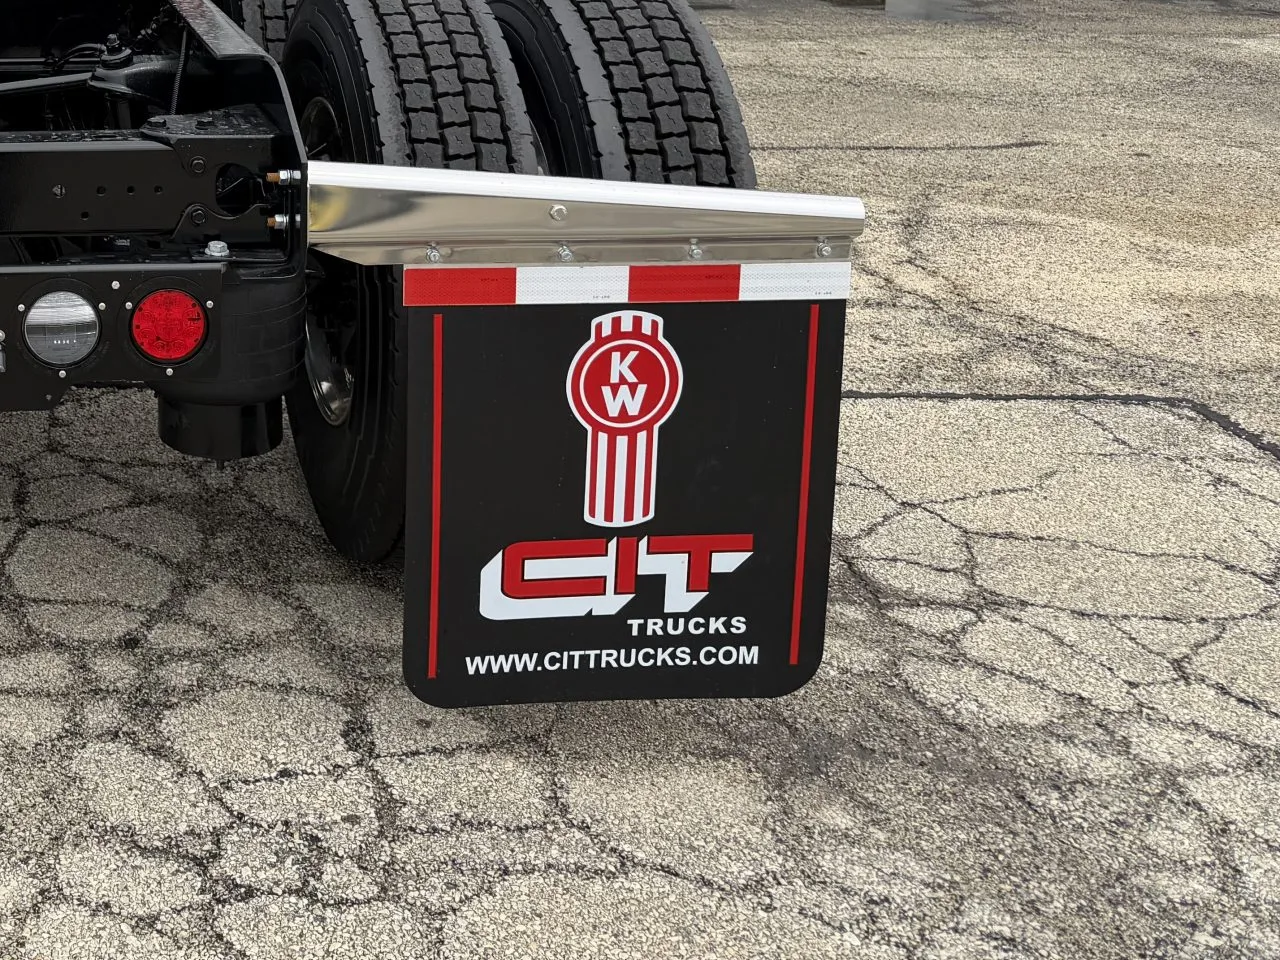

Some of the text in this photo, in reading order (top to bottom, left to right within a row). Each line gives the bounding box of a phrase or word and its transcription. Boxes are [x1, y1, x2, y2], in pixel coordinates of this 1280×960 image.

[478, 534, 754, 621] CIT
[626, 617, 747, 637] TRUCKS
[465, 646, 759, 676] WWW.CITTRUCKS.COM
